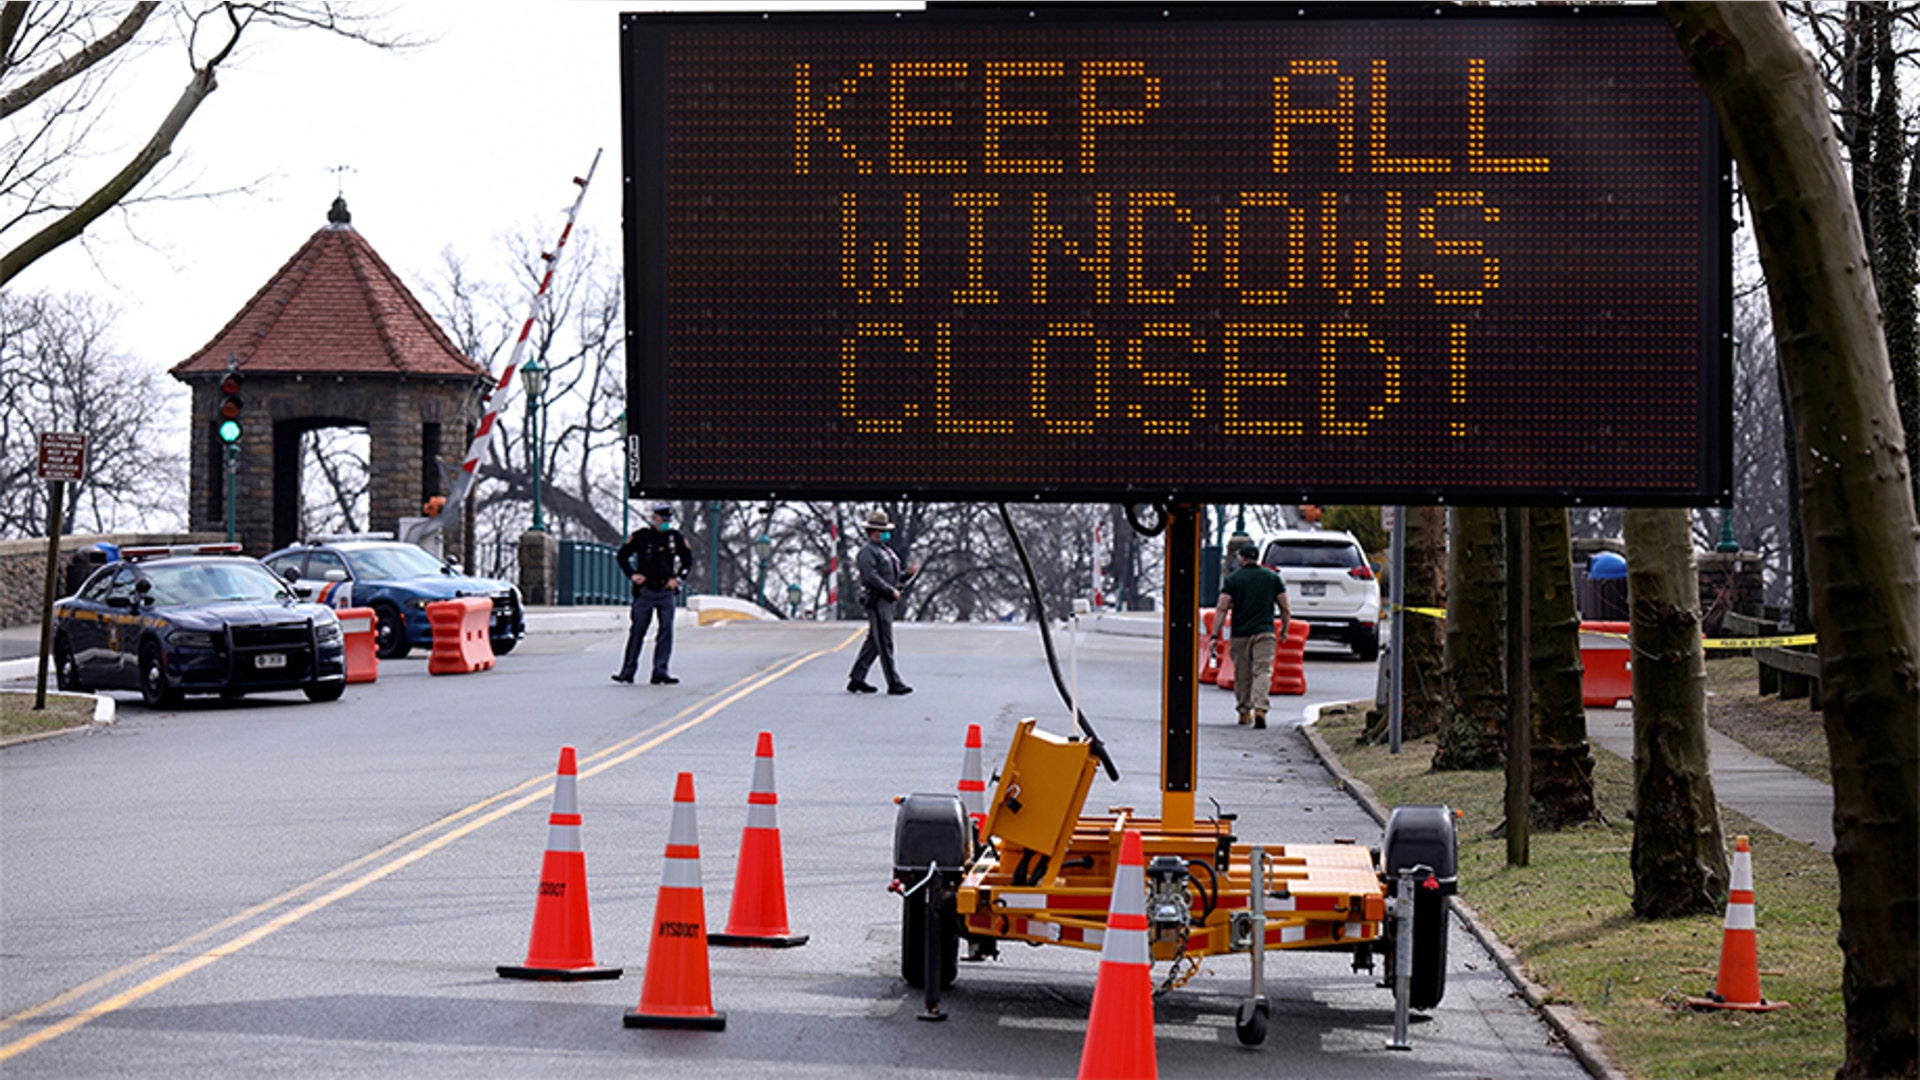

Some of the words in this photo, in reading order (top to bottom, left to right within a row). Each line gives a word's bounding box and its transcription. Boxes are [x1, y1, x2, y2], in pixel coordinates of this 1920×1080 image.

[795, 60, 1161, 175] KEEP
[1272, 58, 1550, 173] ALL
[841, 190, 1501, 305] WINDOWS
[841, 321, 1467, 436] CLOSED!
